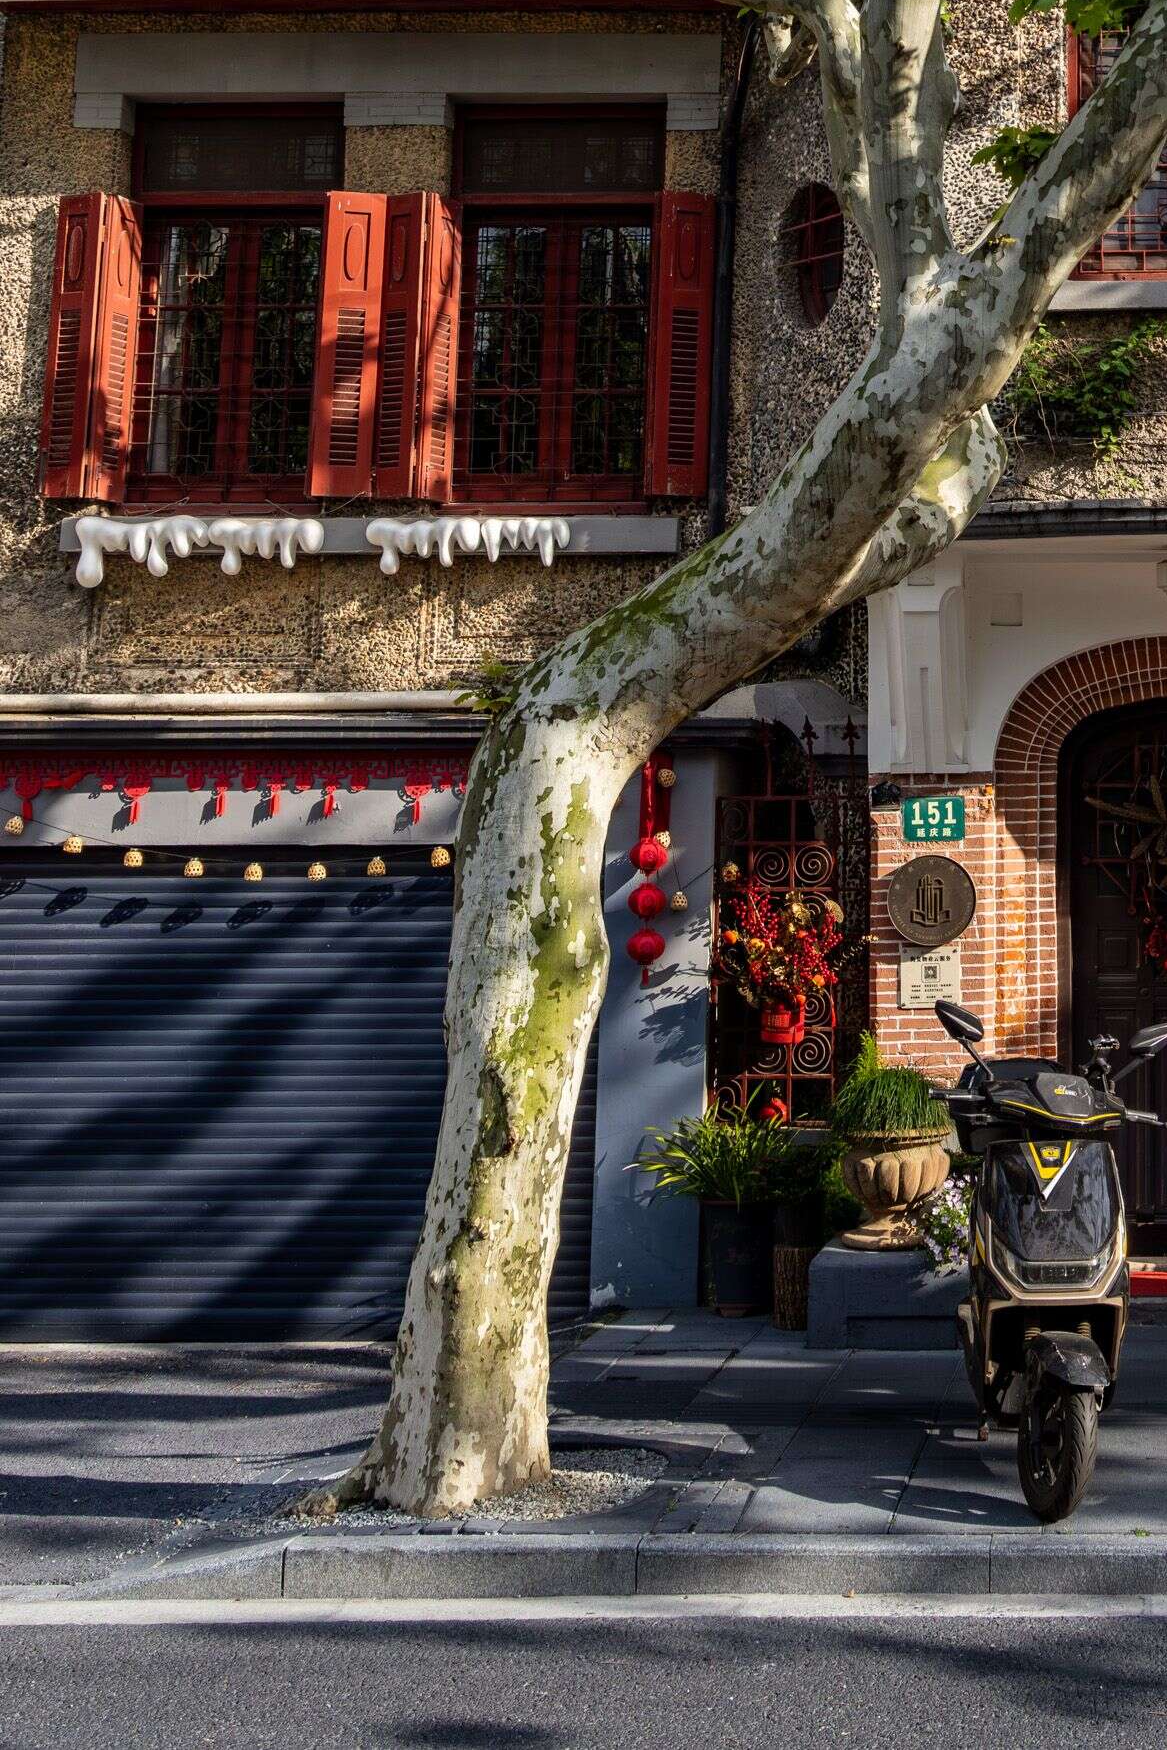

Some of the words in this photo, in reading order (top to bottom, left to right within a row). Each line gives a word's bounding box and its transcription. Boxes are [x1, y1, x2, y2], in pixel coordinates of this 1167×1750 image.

[911, 801, 957, 825] 151
[916, 827, 952, 838] 延庆路
